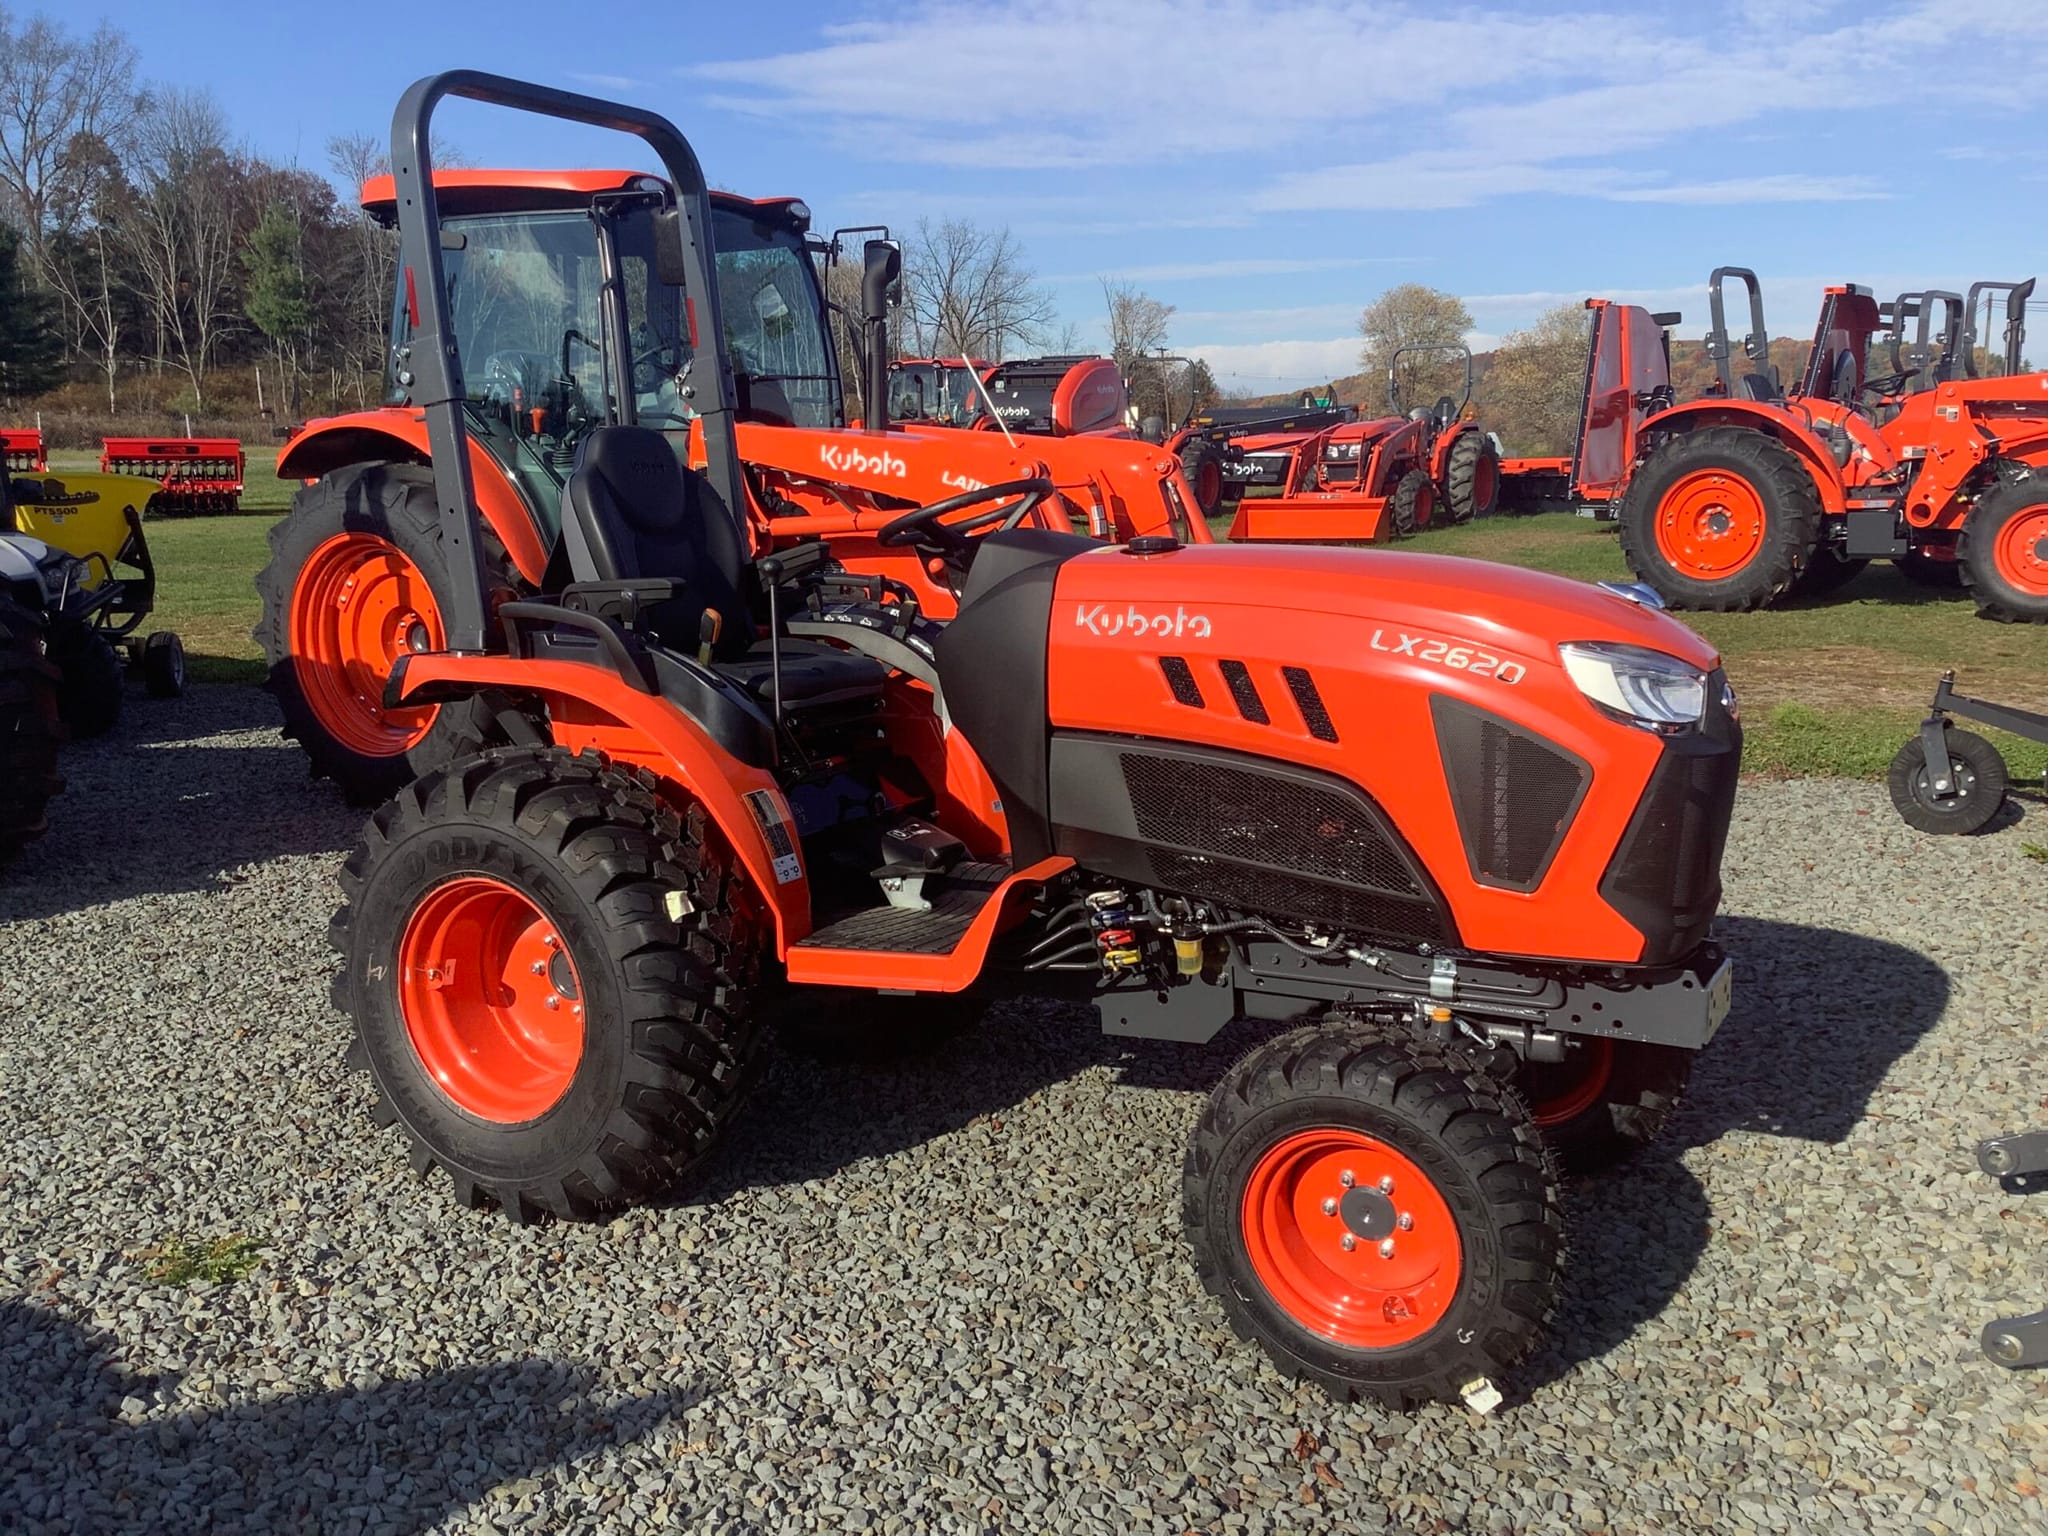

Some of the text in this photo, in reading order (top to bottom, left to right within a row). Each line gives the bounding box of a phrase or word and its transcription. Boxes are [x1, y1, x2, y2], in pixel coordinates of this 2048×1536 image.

[996, 406, 1030, 417] Kubota
[819, 444, 906, 477] Kubota
[1075, 604, 1212, 638] Kubota
[1369, 629, 1527, 685] LX2620
